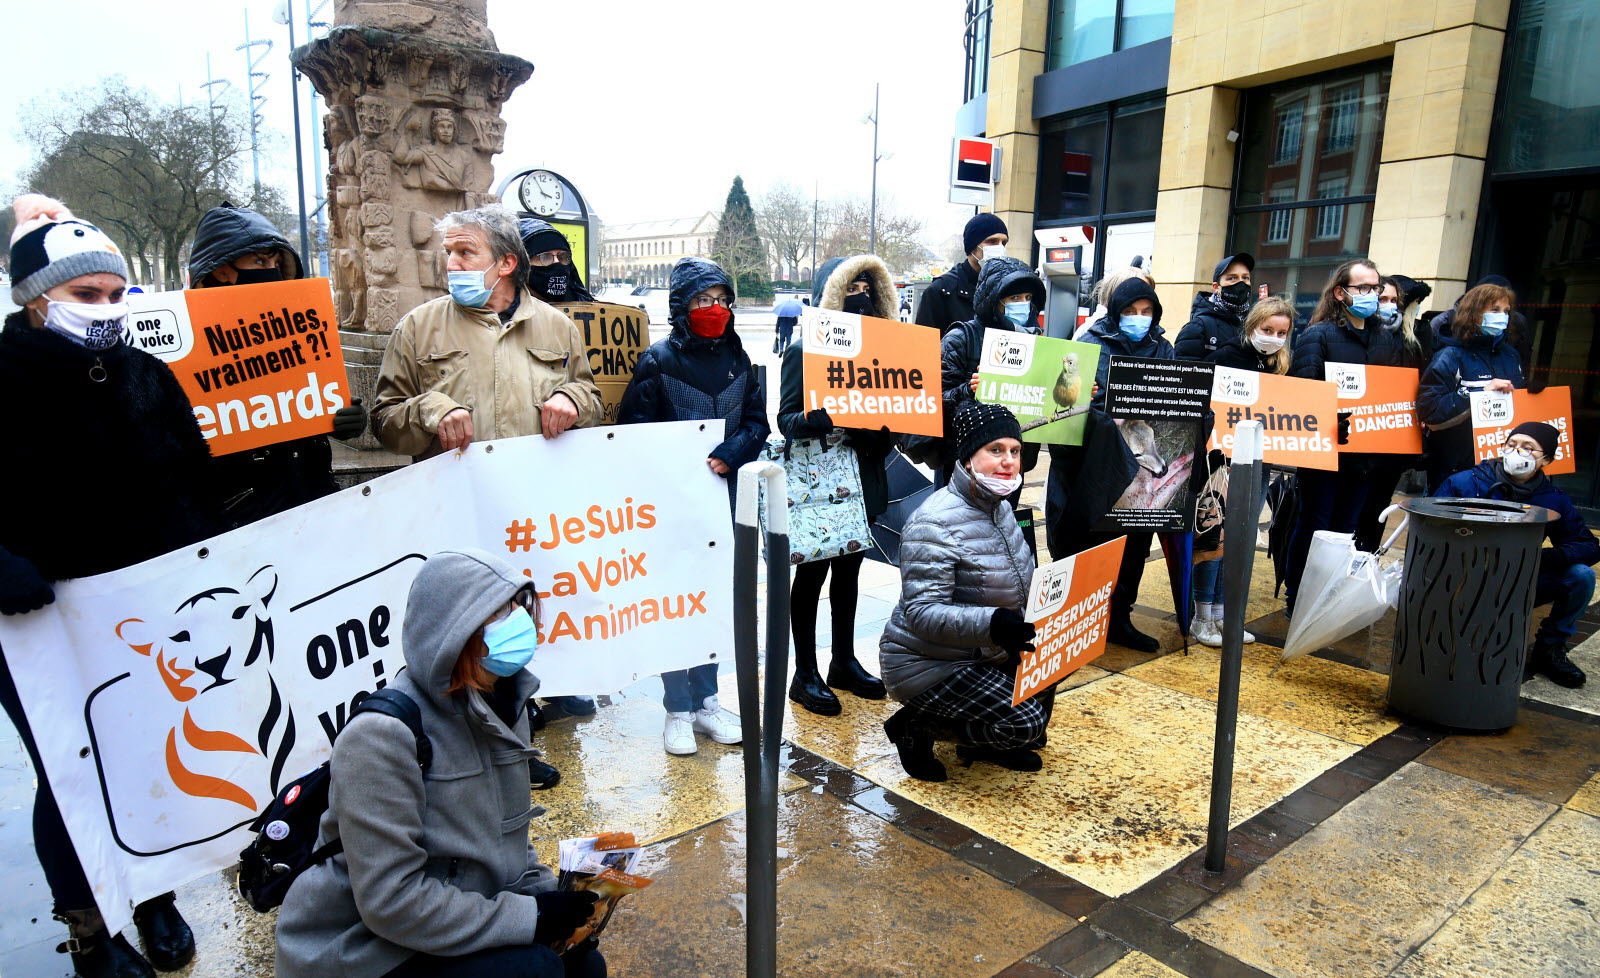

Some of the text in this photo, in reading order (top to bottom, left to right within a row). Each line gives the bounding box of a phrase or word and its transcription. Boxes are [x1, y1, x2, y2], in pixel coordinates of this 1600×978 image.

[538, 174, 546, 183] 12
[525, 188, 530, 197] 9
[555, 191, 560, 200] 3
[540, 205, 546, 214] 6
[92, 320, 105, 329] ON
[136, 318, 161, 331] one
[86, 328, 101, 337] LES
[203, 308, 328, 356] Nuisibles,
[833, 327, 846, 336] one
[140, 331, 174, 348] voice
[833, 336, 851, 347] voice
[1009, 347, 1020, 355] one
[193, 340, 306, 393] vraiment
[1007, 356, 1022, 365] voice
[827, 358, 923, 389] #Jaime
[981, 380, 1047, 405] LA CHASSE
[1133, 384, 1147, 392] ÊTRES
[1234, 388, 1249, 396] voice
[192, 372, 344, 440] enards
[1493, 409, 1505, 417] voice
[1355, 413, 1413, 432] DANGER
[1212, 429, 1333, 452] Leenards
[505, 497, 657, 552] #JeSuis
[1052, 579, 1062, 589] one
[1049, 588, 1062, 602] voice
[1024, 581, 1113, 655] RÉSERVONS
[306, 605, 390, 680] one
[1022, 598, 1109, 675] LA BIODIVERSITÉ
[1019, 653, 1062, 698] POUR
[1066, 622, 1100, 663] TOUS
